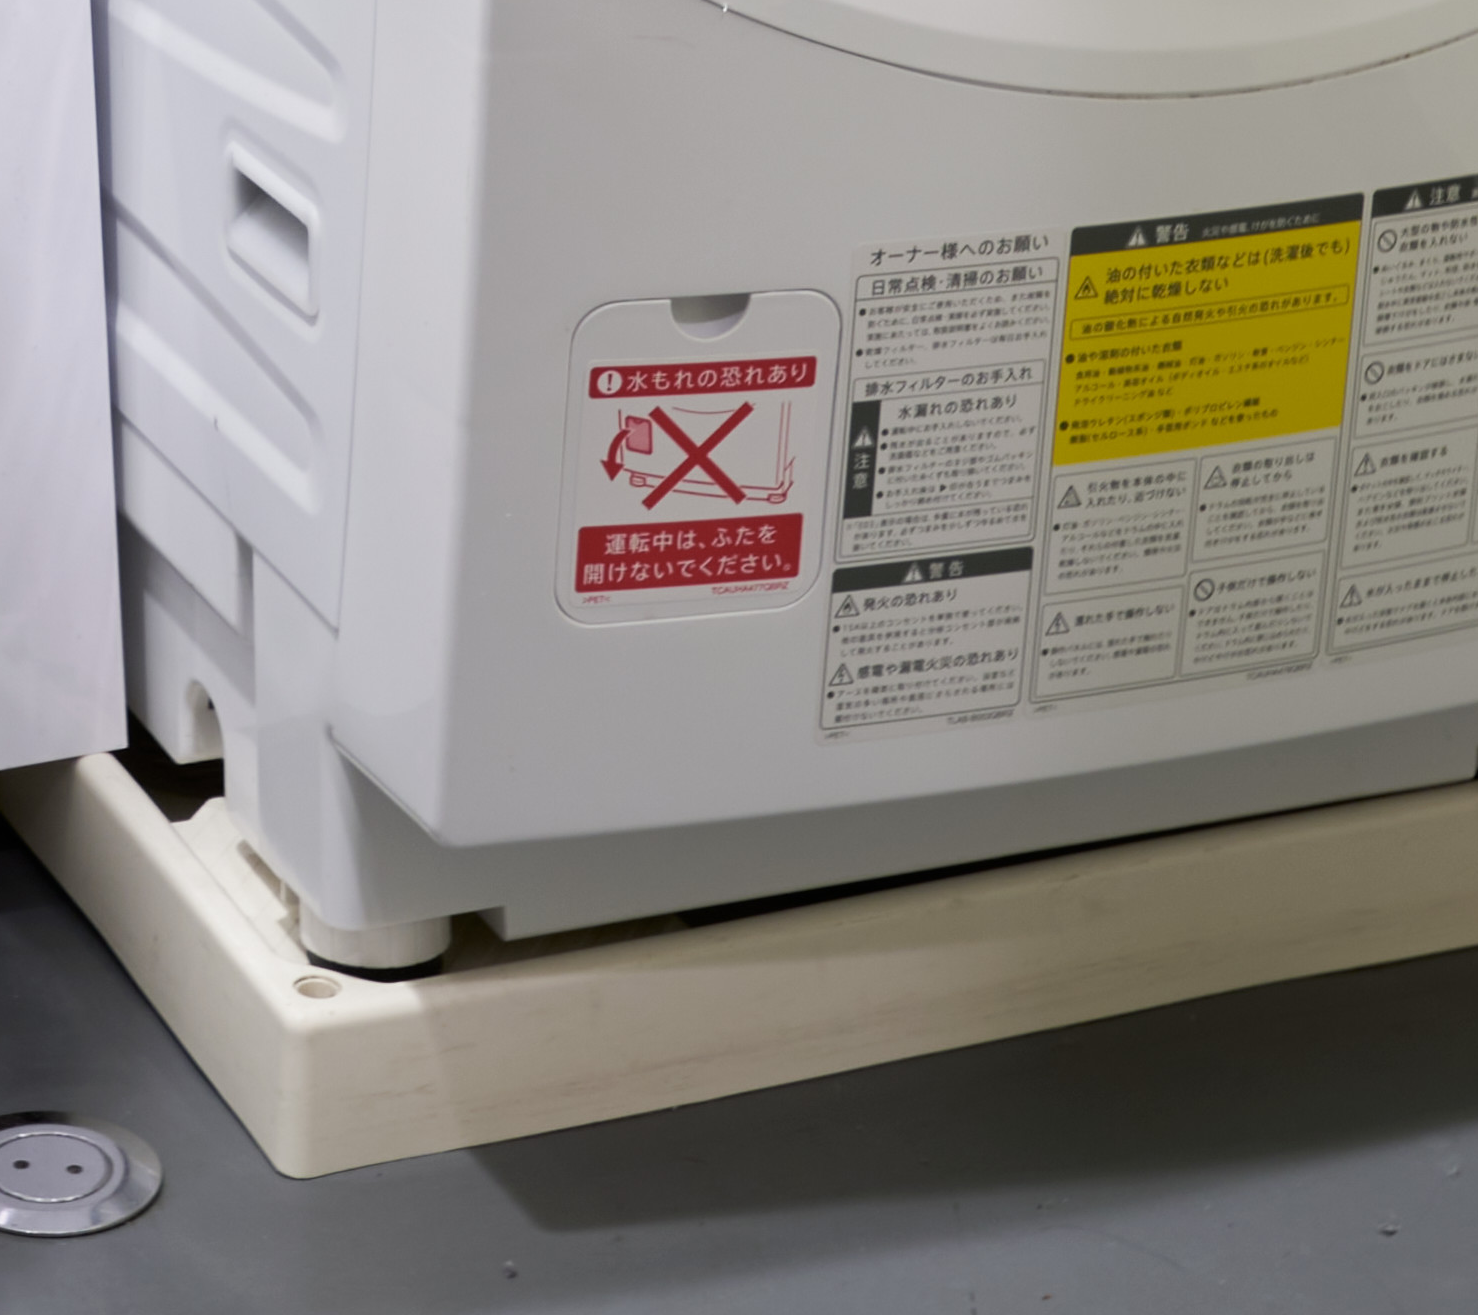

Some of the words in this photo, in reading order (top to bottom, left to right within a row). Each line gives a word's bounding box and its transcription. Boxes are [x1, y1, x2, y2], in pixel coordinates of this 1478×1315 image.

[870, 234, 1048, 266] オーナー様へのお願い
[627, 364, 807, 392] 水もれの恐れあり
[605, 525, 776, 555] 運転中は、ふたを
[583, 554, 791, 585] 開けないでください。
